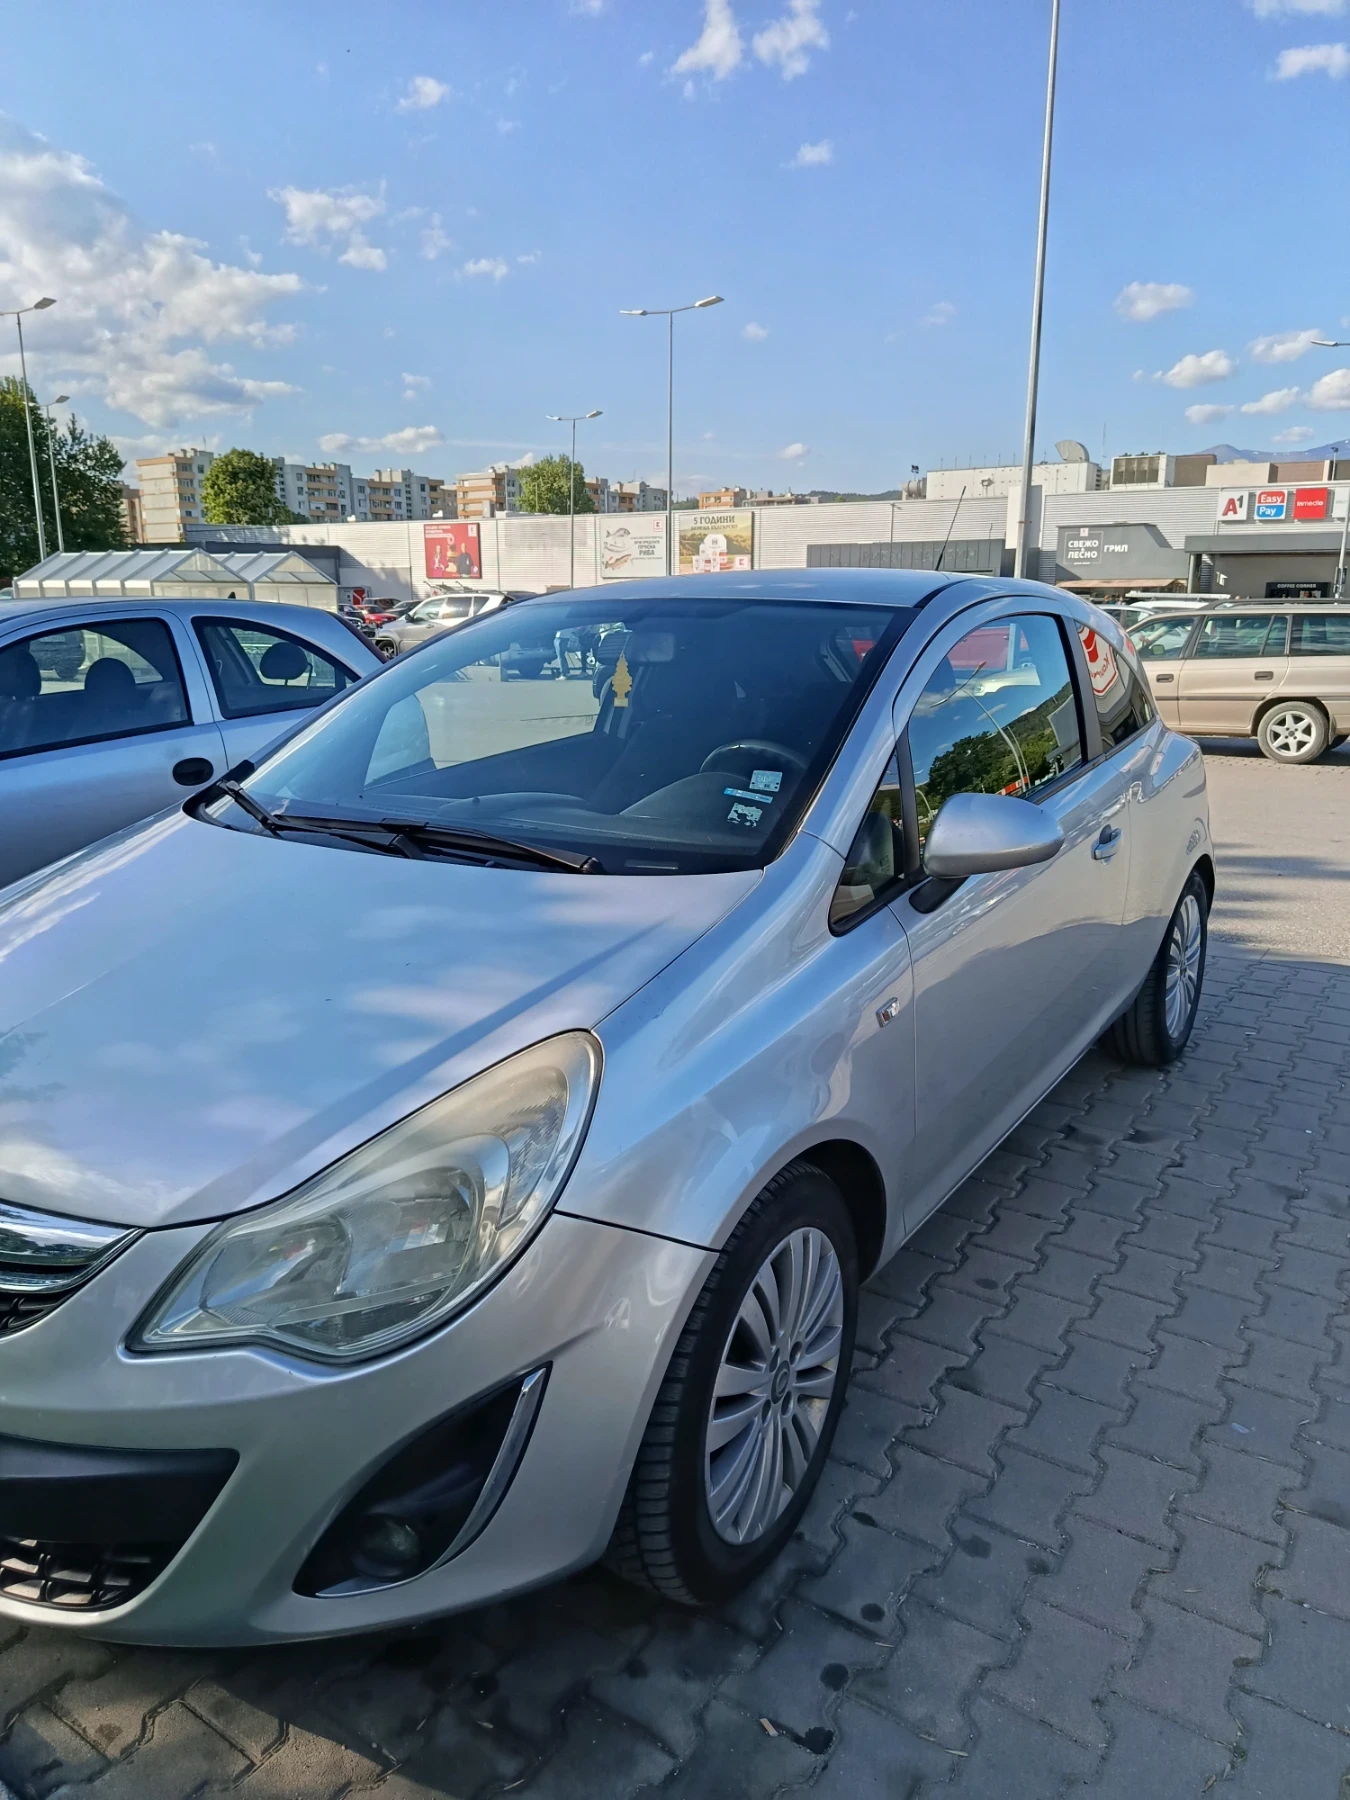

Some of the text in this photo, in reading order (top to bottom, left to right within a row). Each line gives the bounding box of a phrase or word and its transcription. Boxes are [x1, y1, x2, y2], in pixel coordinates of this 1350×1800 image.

[1260, 494, 1283, 504] Easy
[1222, 495, 1243, 516] A1
[1259, 507, 1276, 516] Pay
[693, 515, 735, 525] 5 ГОДИНИ
[1068, 540, 1099, 548] СВЕЖО
[1104, 544, 1128, 552] ГРИЛ
[1067, 551, 1098, 559] ЛЕСНО
